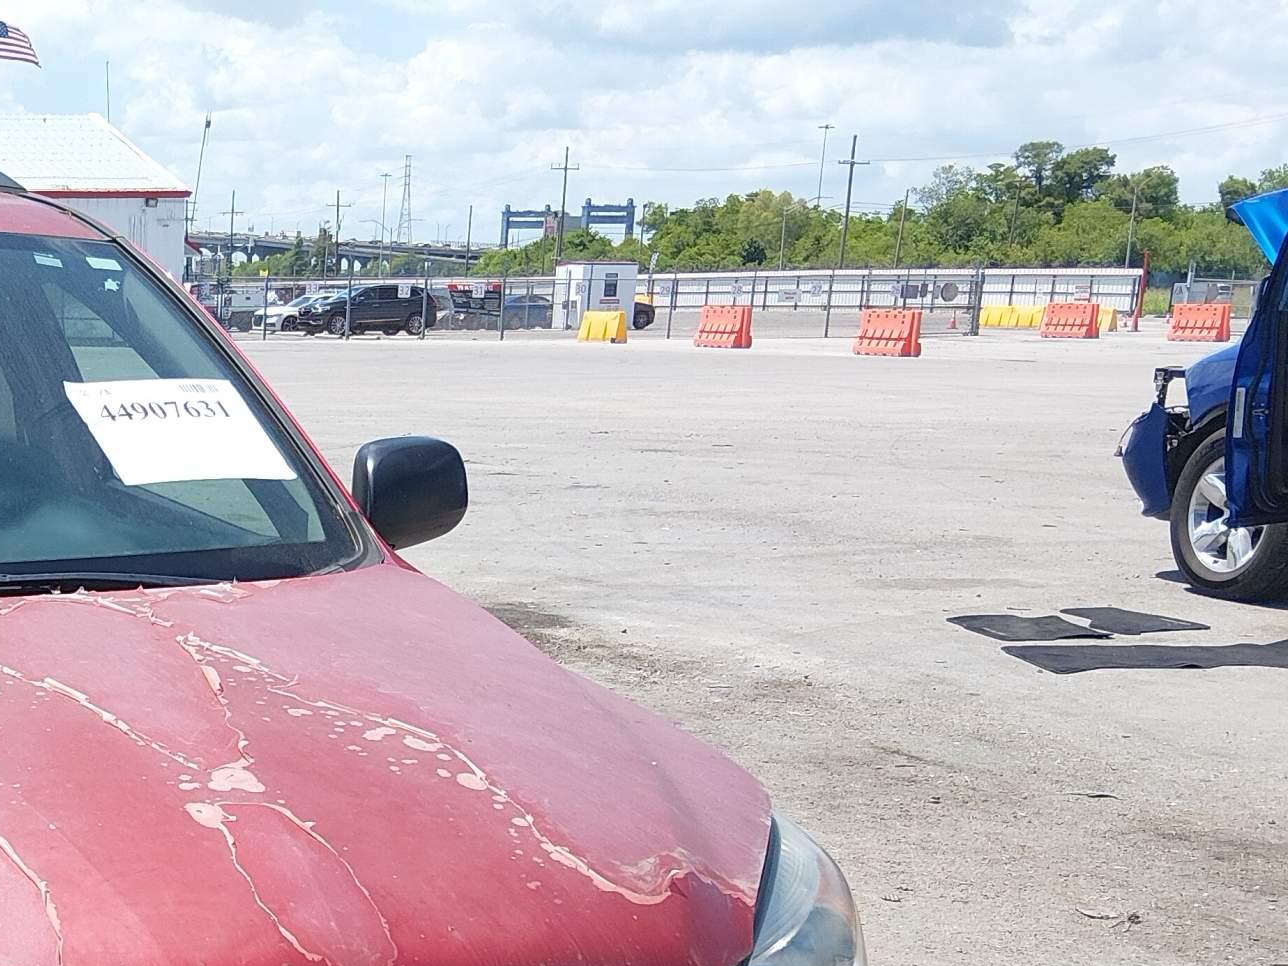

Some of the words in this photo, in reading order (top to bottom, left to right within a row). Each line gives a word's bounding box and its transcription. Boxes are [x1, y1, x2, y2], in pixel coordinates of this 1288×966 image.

[474, 286, 484, 295] 31
[660, 286, 671, 295] 29
[100, 400, 231, 422] 44907631
